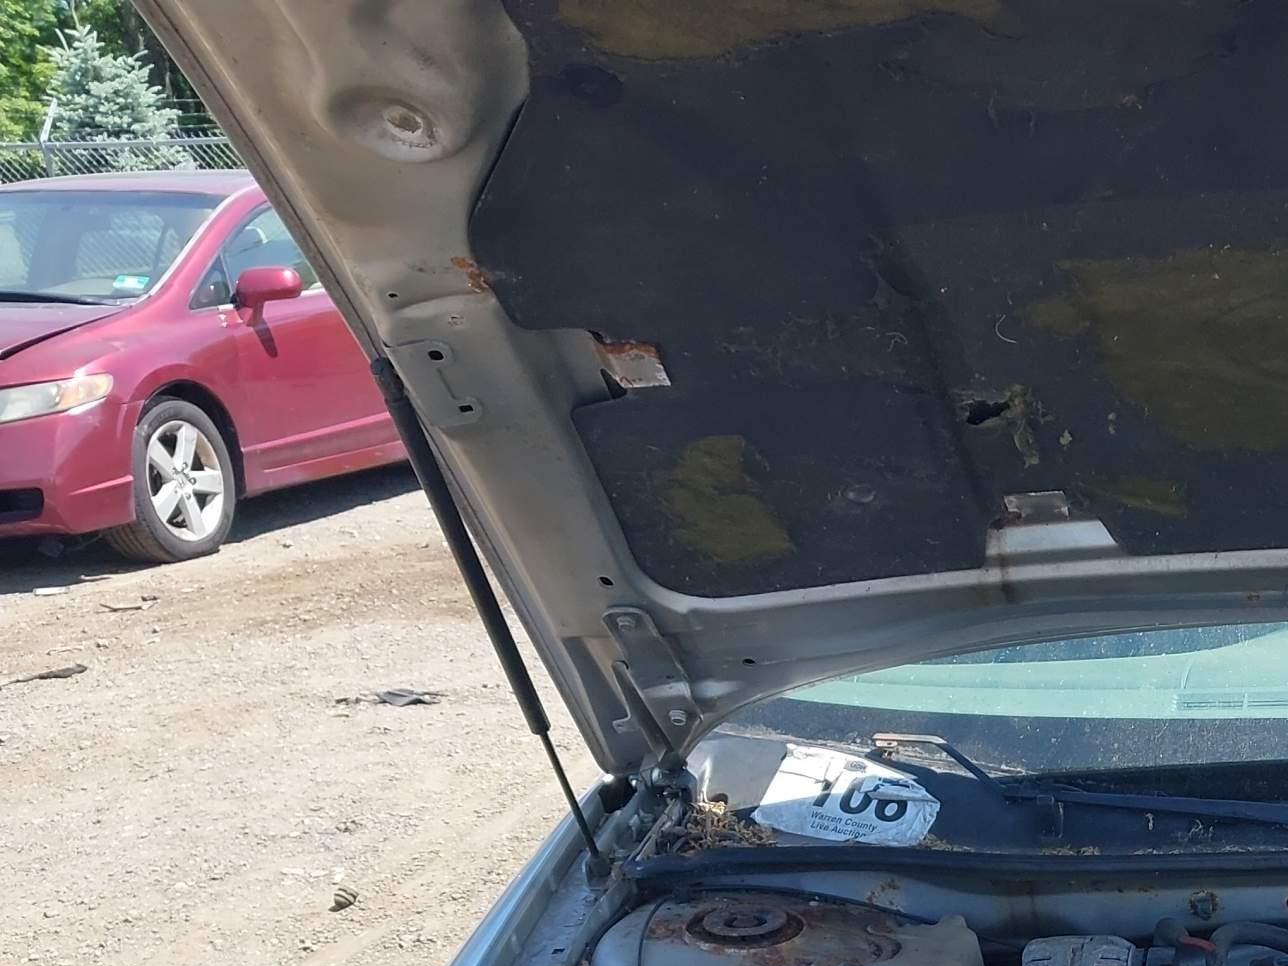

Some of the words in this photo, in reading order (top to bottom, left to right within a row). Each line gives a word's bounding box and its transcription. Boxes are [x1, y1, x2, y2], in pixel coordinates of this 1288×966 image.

[810, 809, 844, 825] Warren
[844, 817, 878, 833] County
[810, 820, 830, 831] Live
